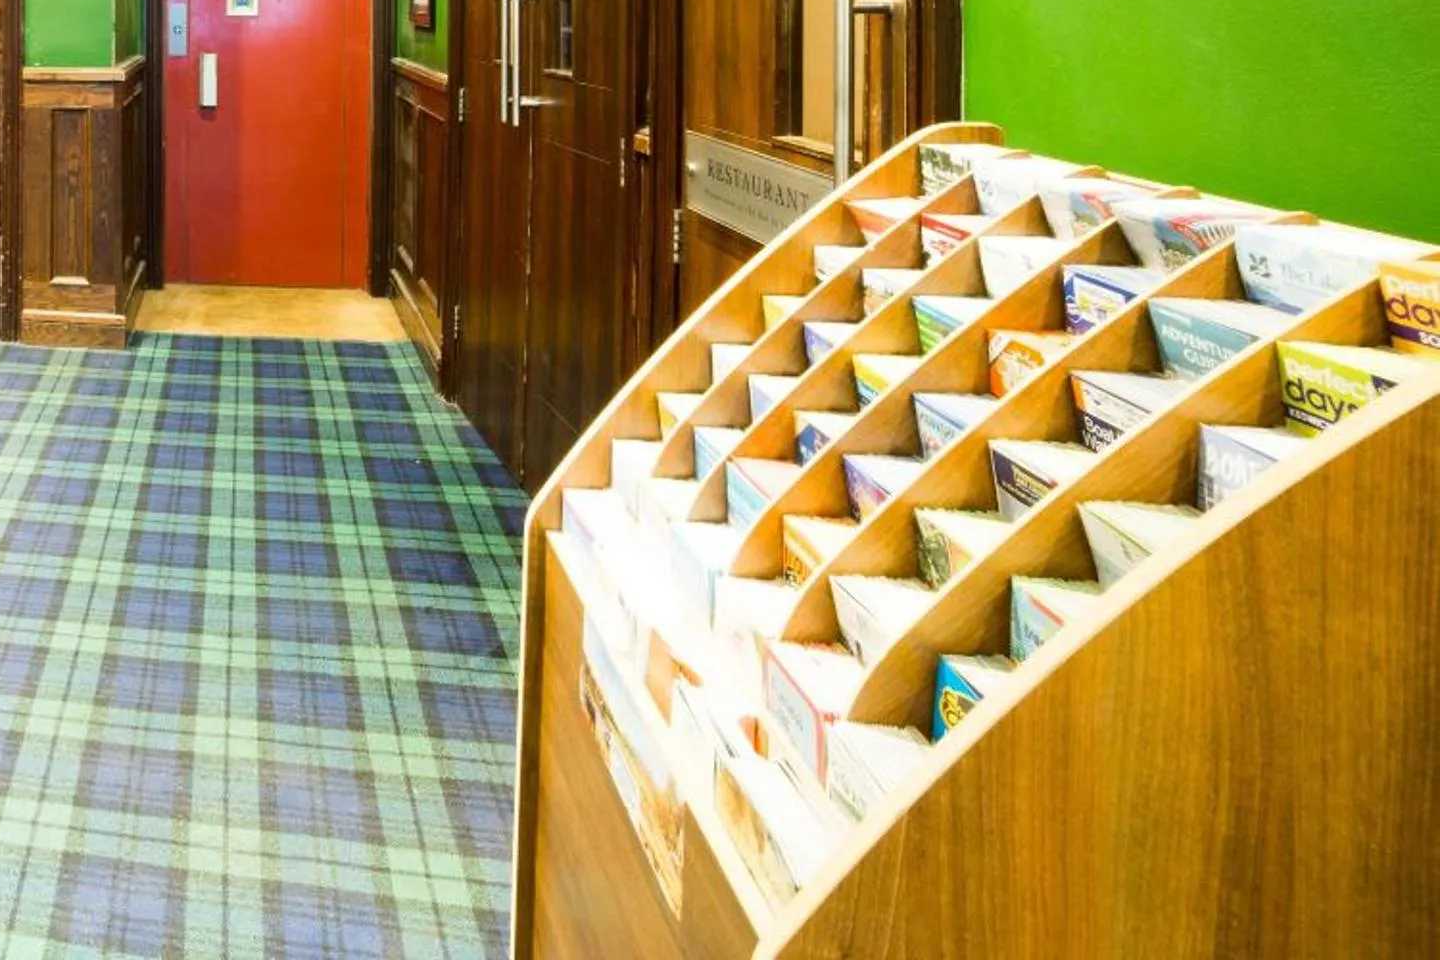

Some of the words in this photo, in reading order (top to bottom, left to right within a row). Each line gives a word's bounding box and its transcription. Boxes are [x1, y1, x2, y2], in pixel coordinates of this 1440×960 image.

[707, 159, 810, 213] RESTAURANT
[1387, 293, 1440, 329] da
[1161, 323, 1236, 362] ADVENTUR
